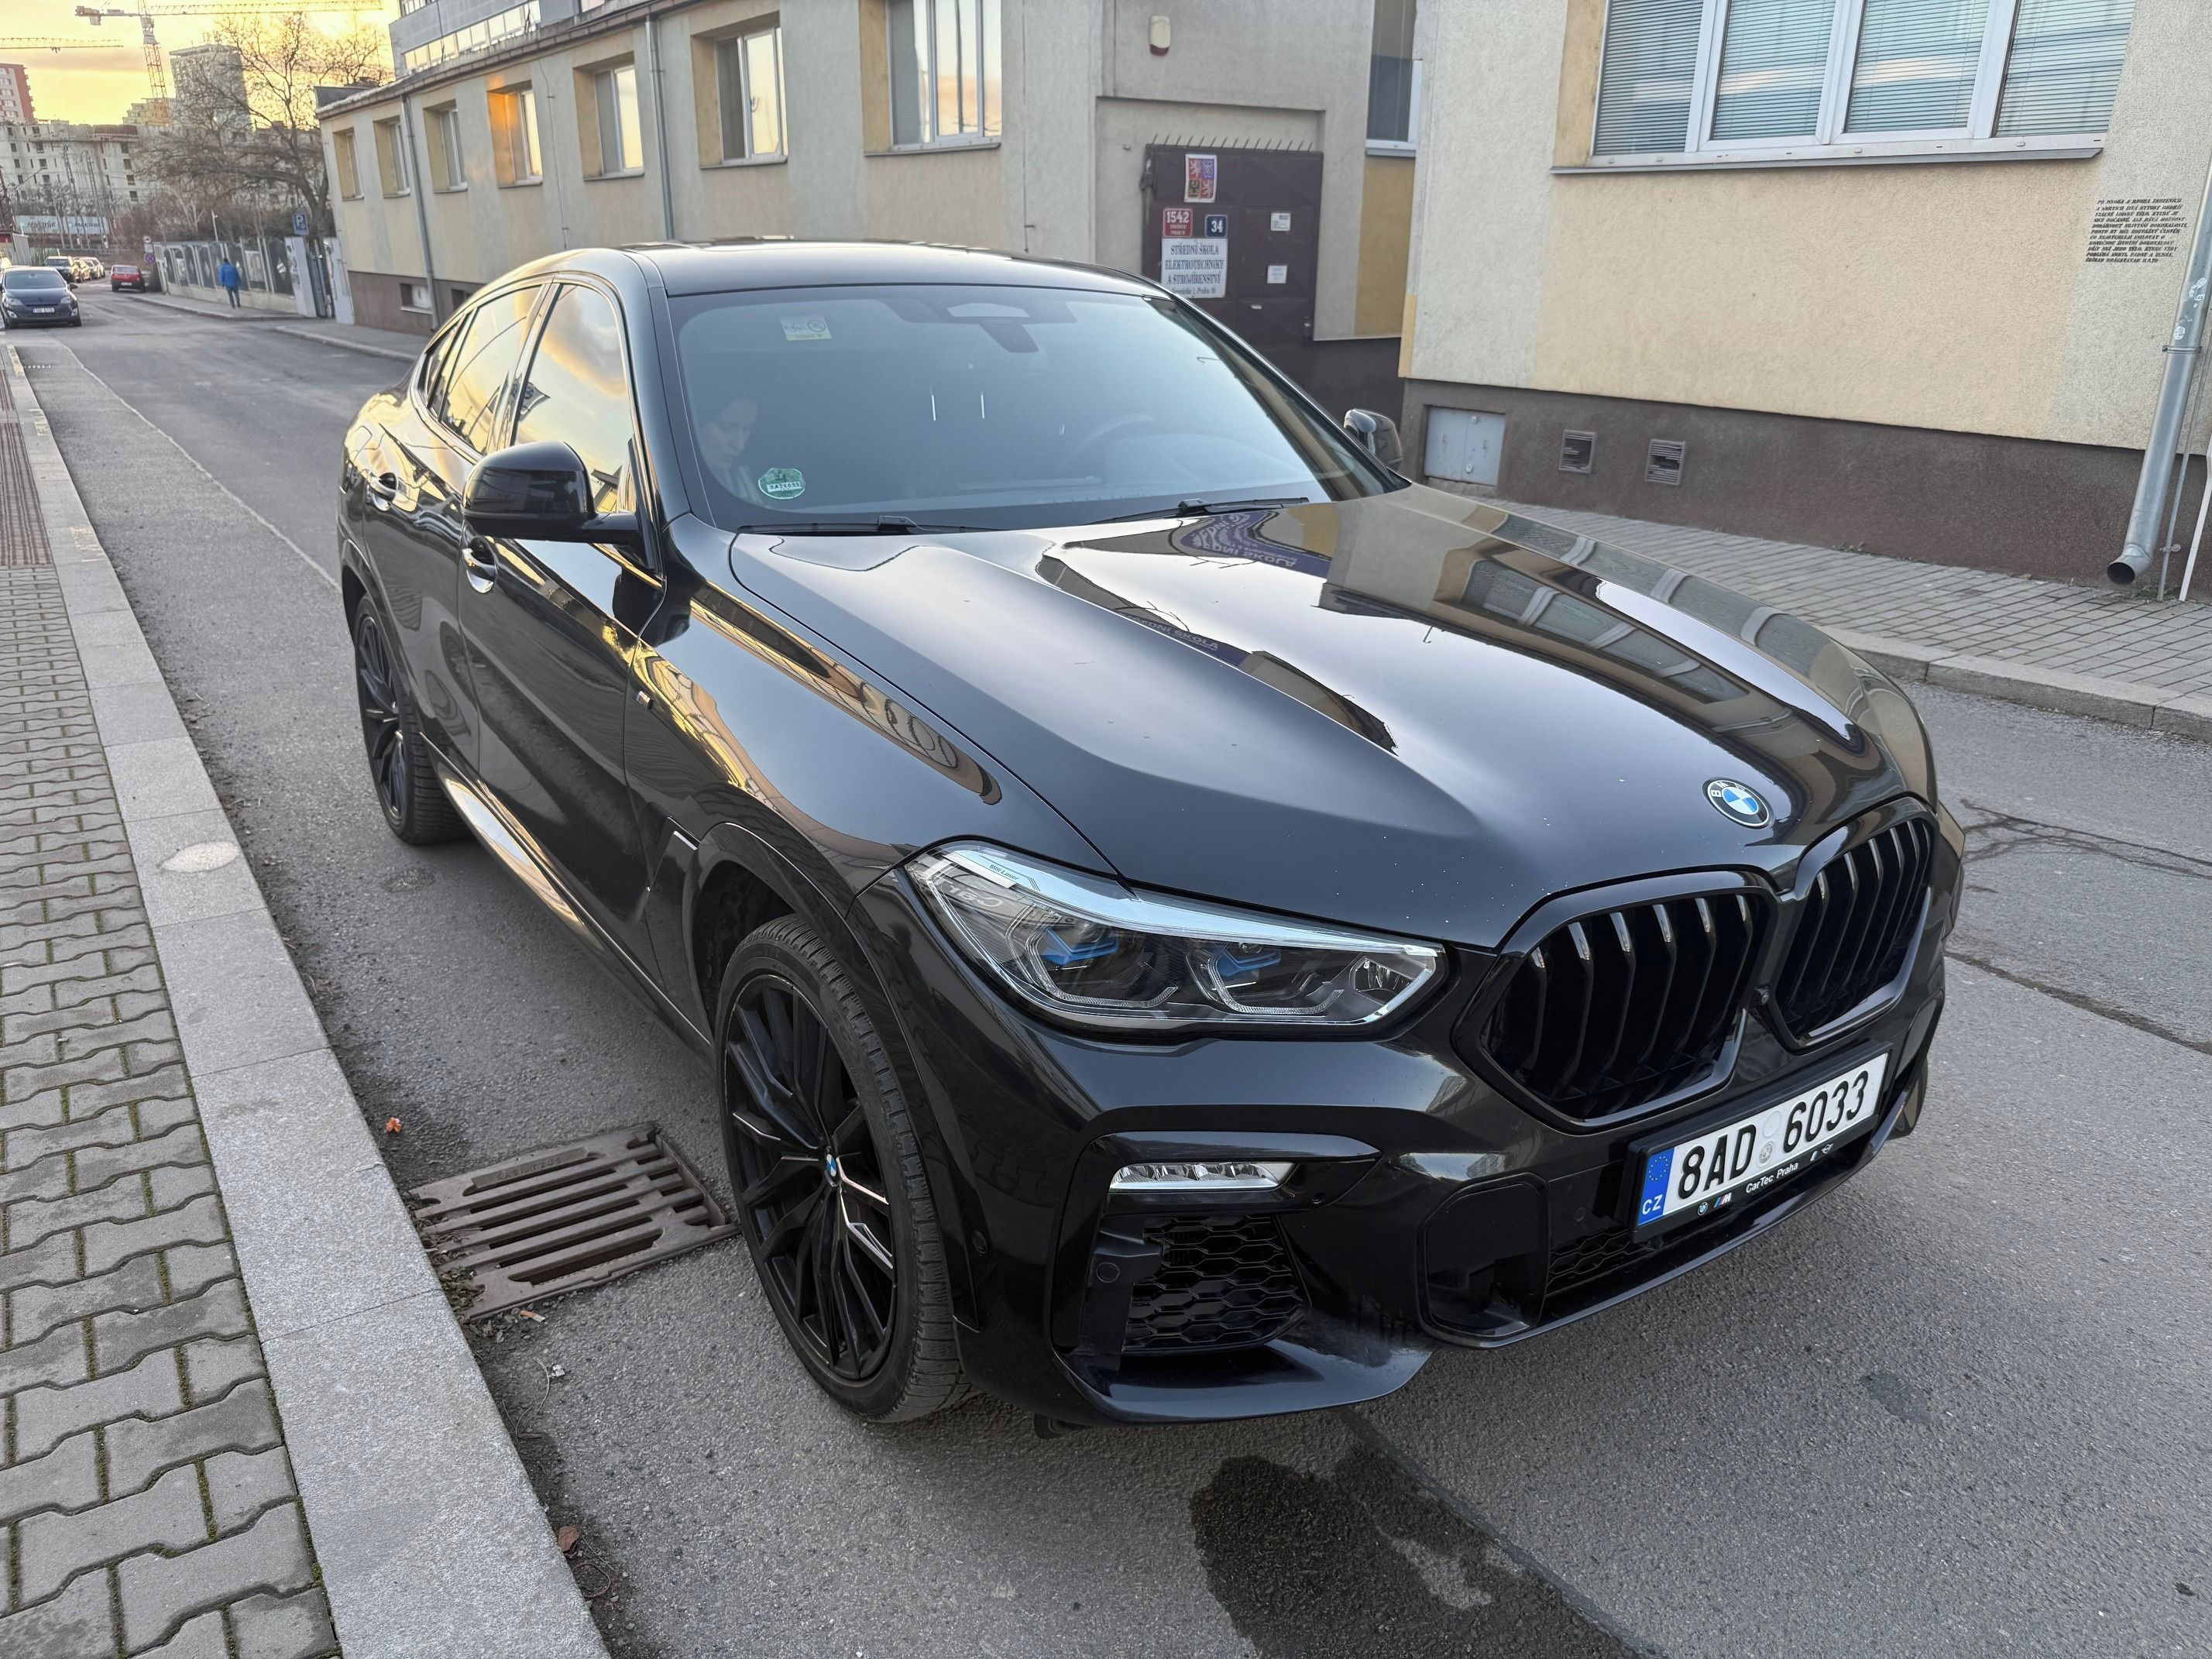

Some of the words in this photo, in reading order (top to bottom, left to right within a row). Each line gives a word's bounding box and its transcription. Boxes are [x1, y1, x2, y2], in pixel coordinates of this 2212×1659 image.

[1166, 211, 1189, 223] 1542
[1211, 220, 1224, 233] 34
[1001, 870, 1019, 880] Laser
[1678, 1124, 1757, 1200] 8AD
[1783, 1070, 1869, 1154] 6033
[1746, 1175, 1774, 1194] CarTec
[1776, 1163, 1799, 1179] Praha
[1642, 1194, 1664, 1215] CZ
